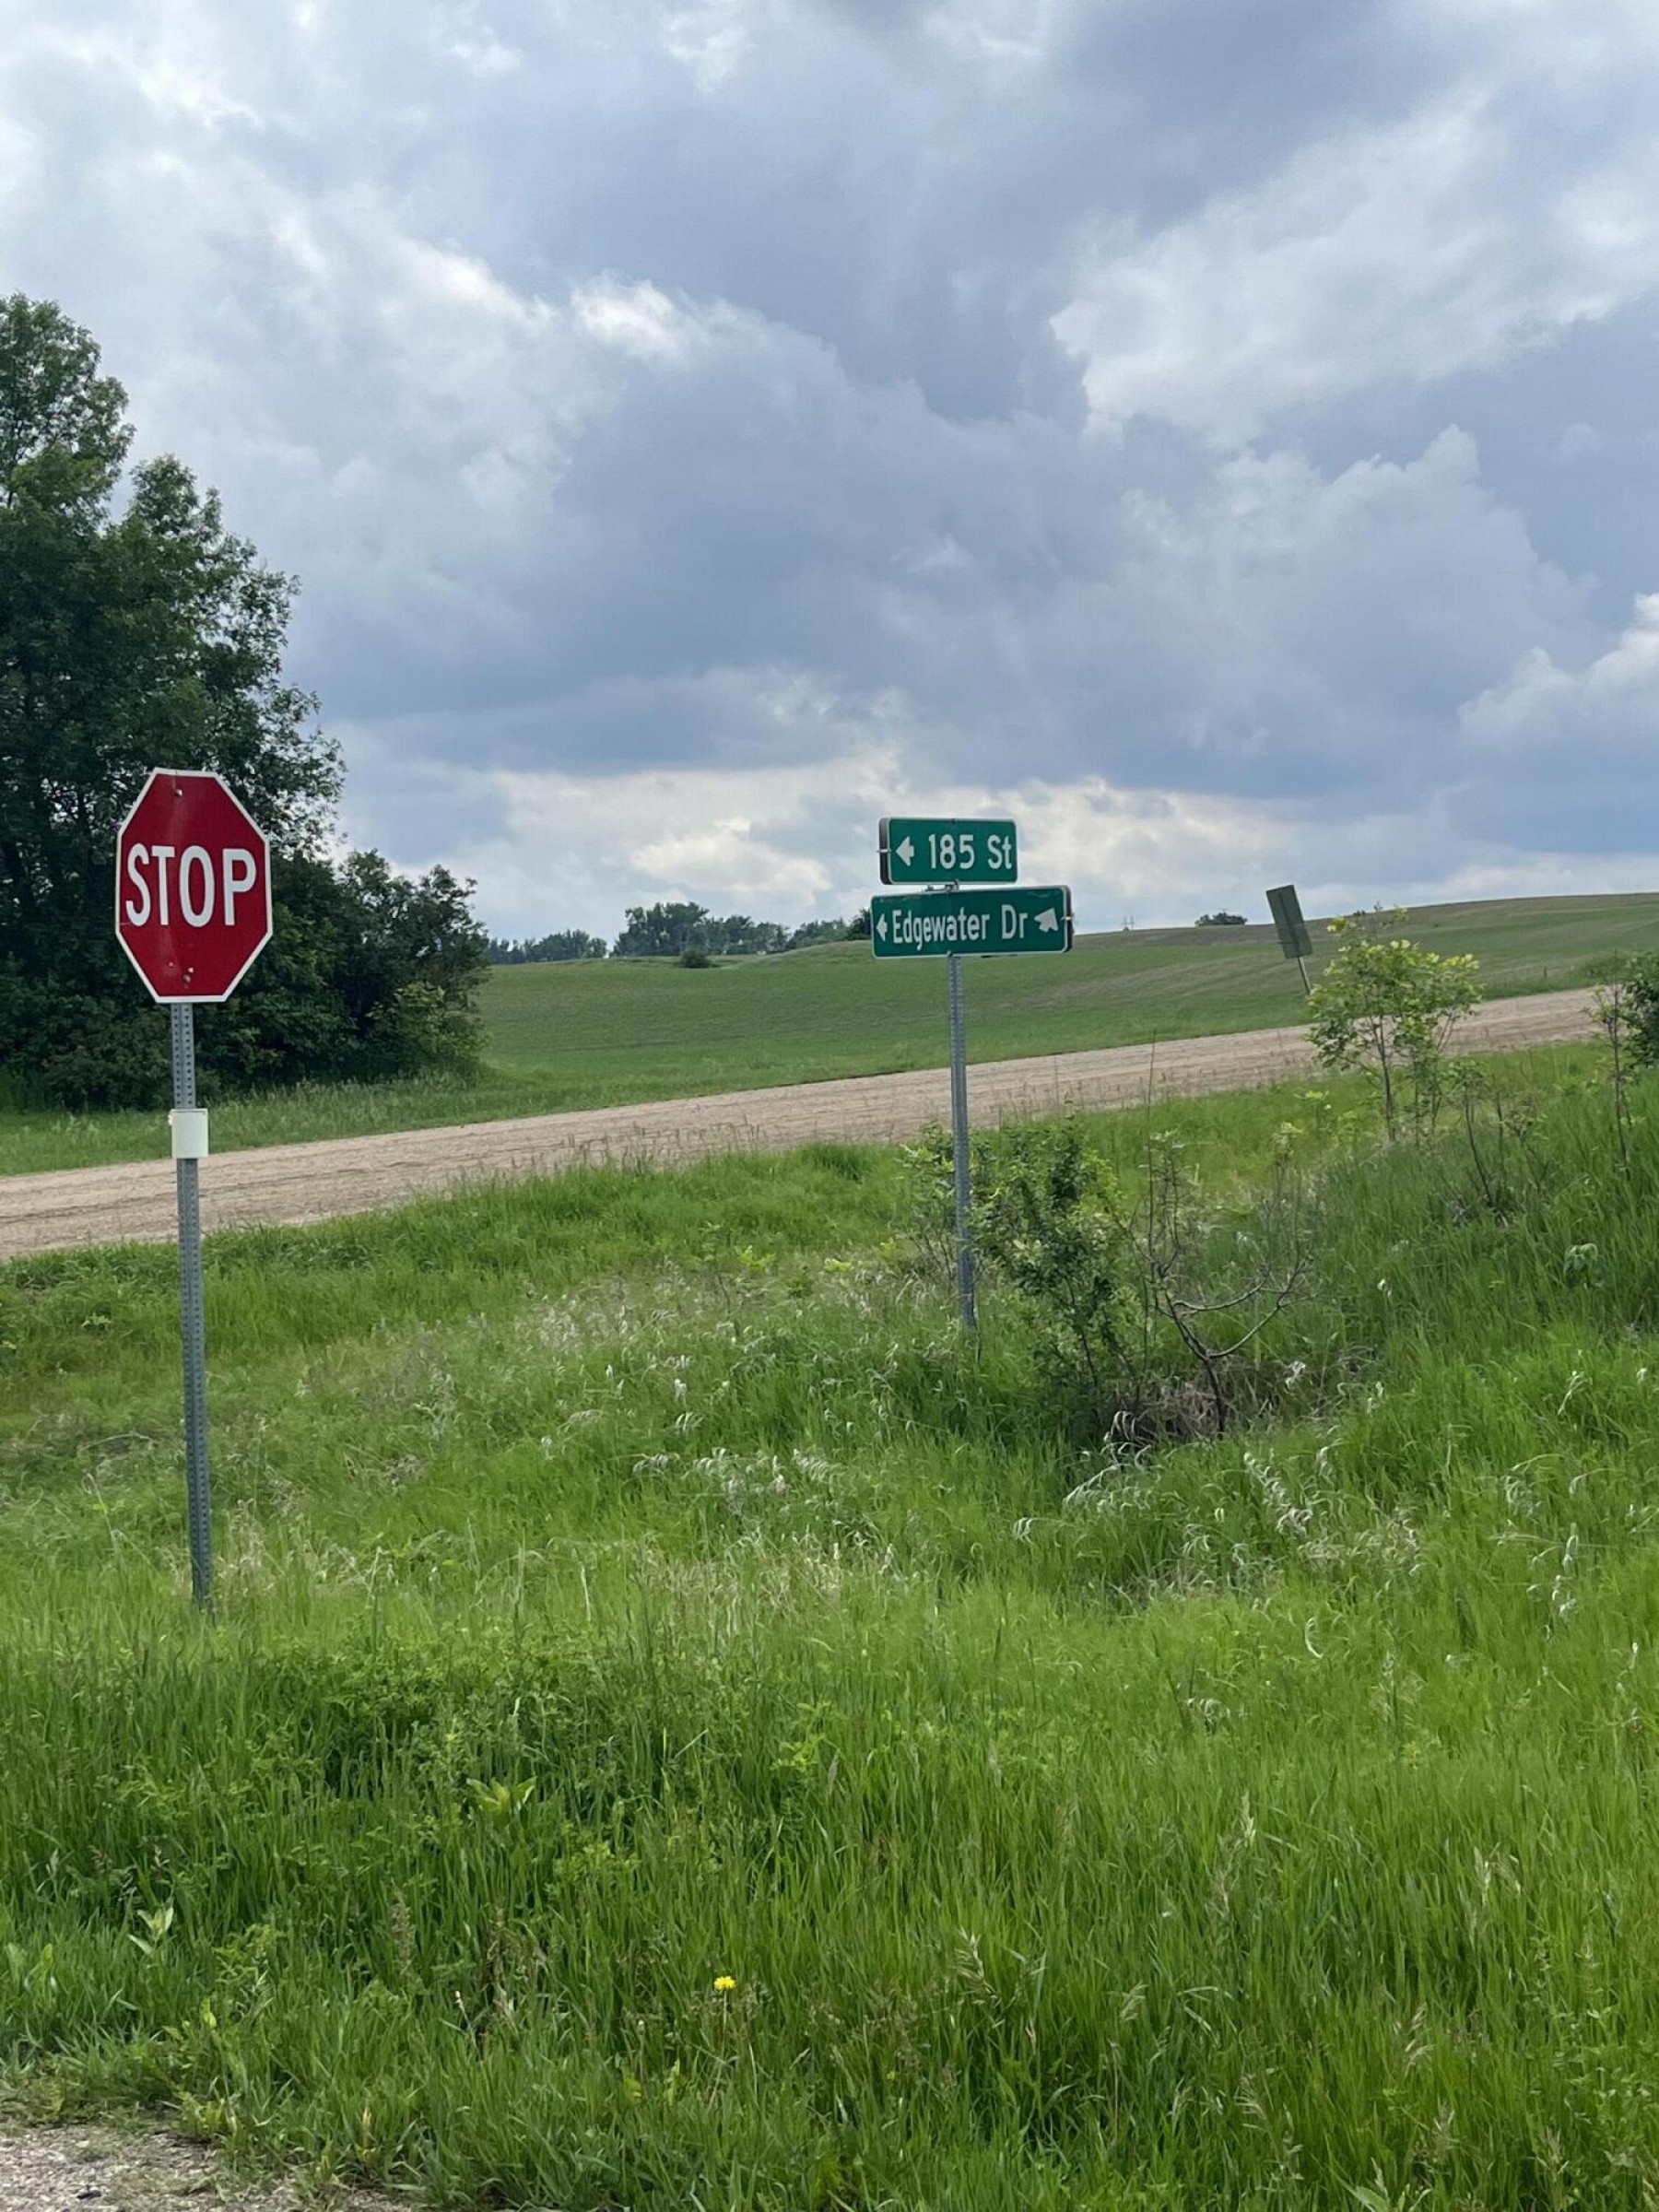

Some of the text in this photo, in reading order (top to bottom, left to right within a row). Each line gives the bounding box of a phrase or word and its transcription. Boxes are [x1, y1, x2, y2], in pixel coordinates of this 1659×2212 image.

[928, 834, 1012, 869] 185 St
[125, 843, 256, 927] STOP
[892, 904, 1028, 951] Edgewater Dr
